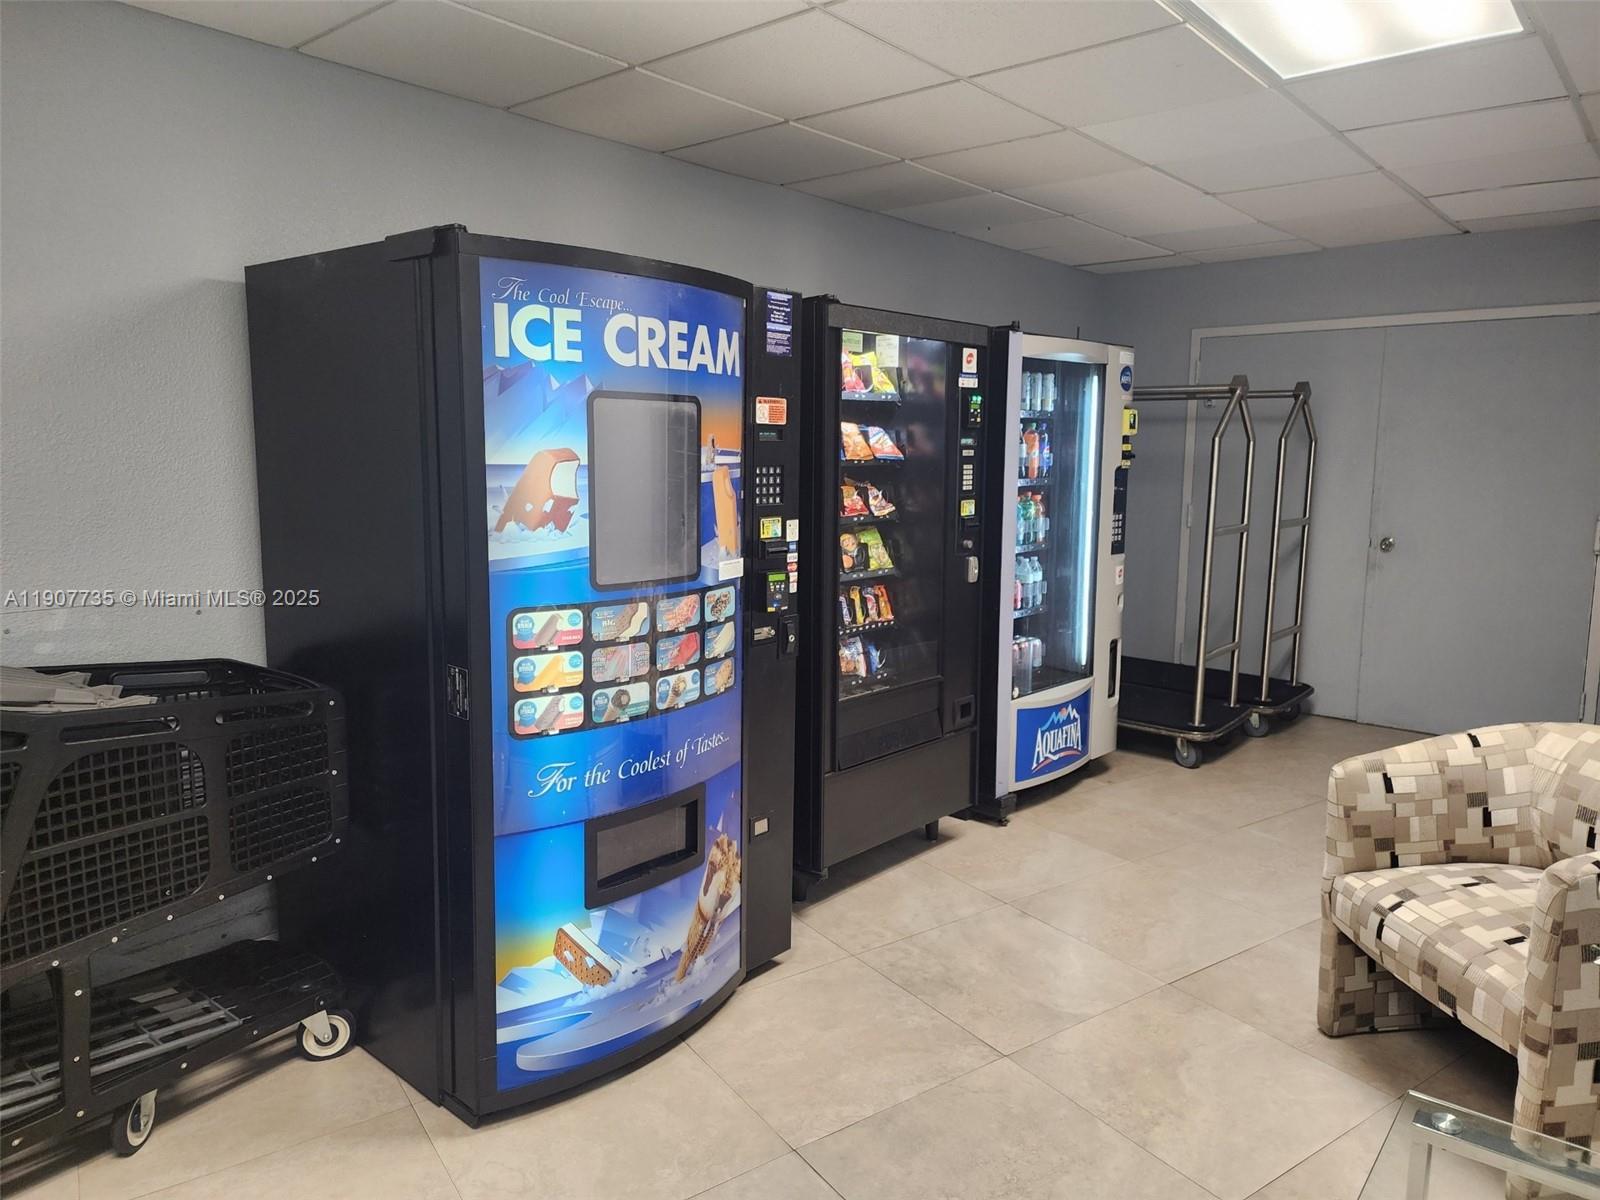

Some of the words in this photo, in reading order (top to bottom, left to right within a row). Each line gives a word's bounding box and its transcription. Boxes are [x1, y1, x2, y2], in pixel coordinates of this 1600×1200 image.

[492, 277, 531, 301] The
[538, 288, 569, 305] Cool
[493, 302, 583, 363] ICE
[604, 312, 741, 377] CREAM
[527, 761, 577, 798] For
[584, 762, 611, 788] the
[618, 750, 672, 779] Coolest
[676, 738, 691, 769] of
[1031, 716, 1082, 770] AQUAFINA
